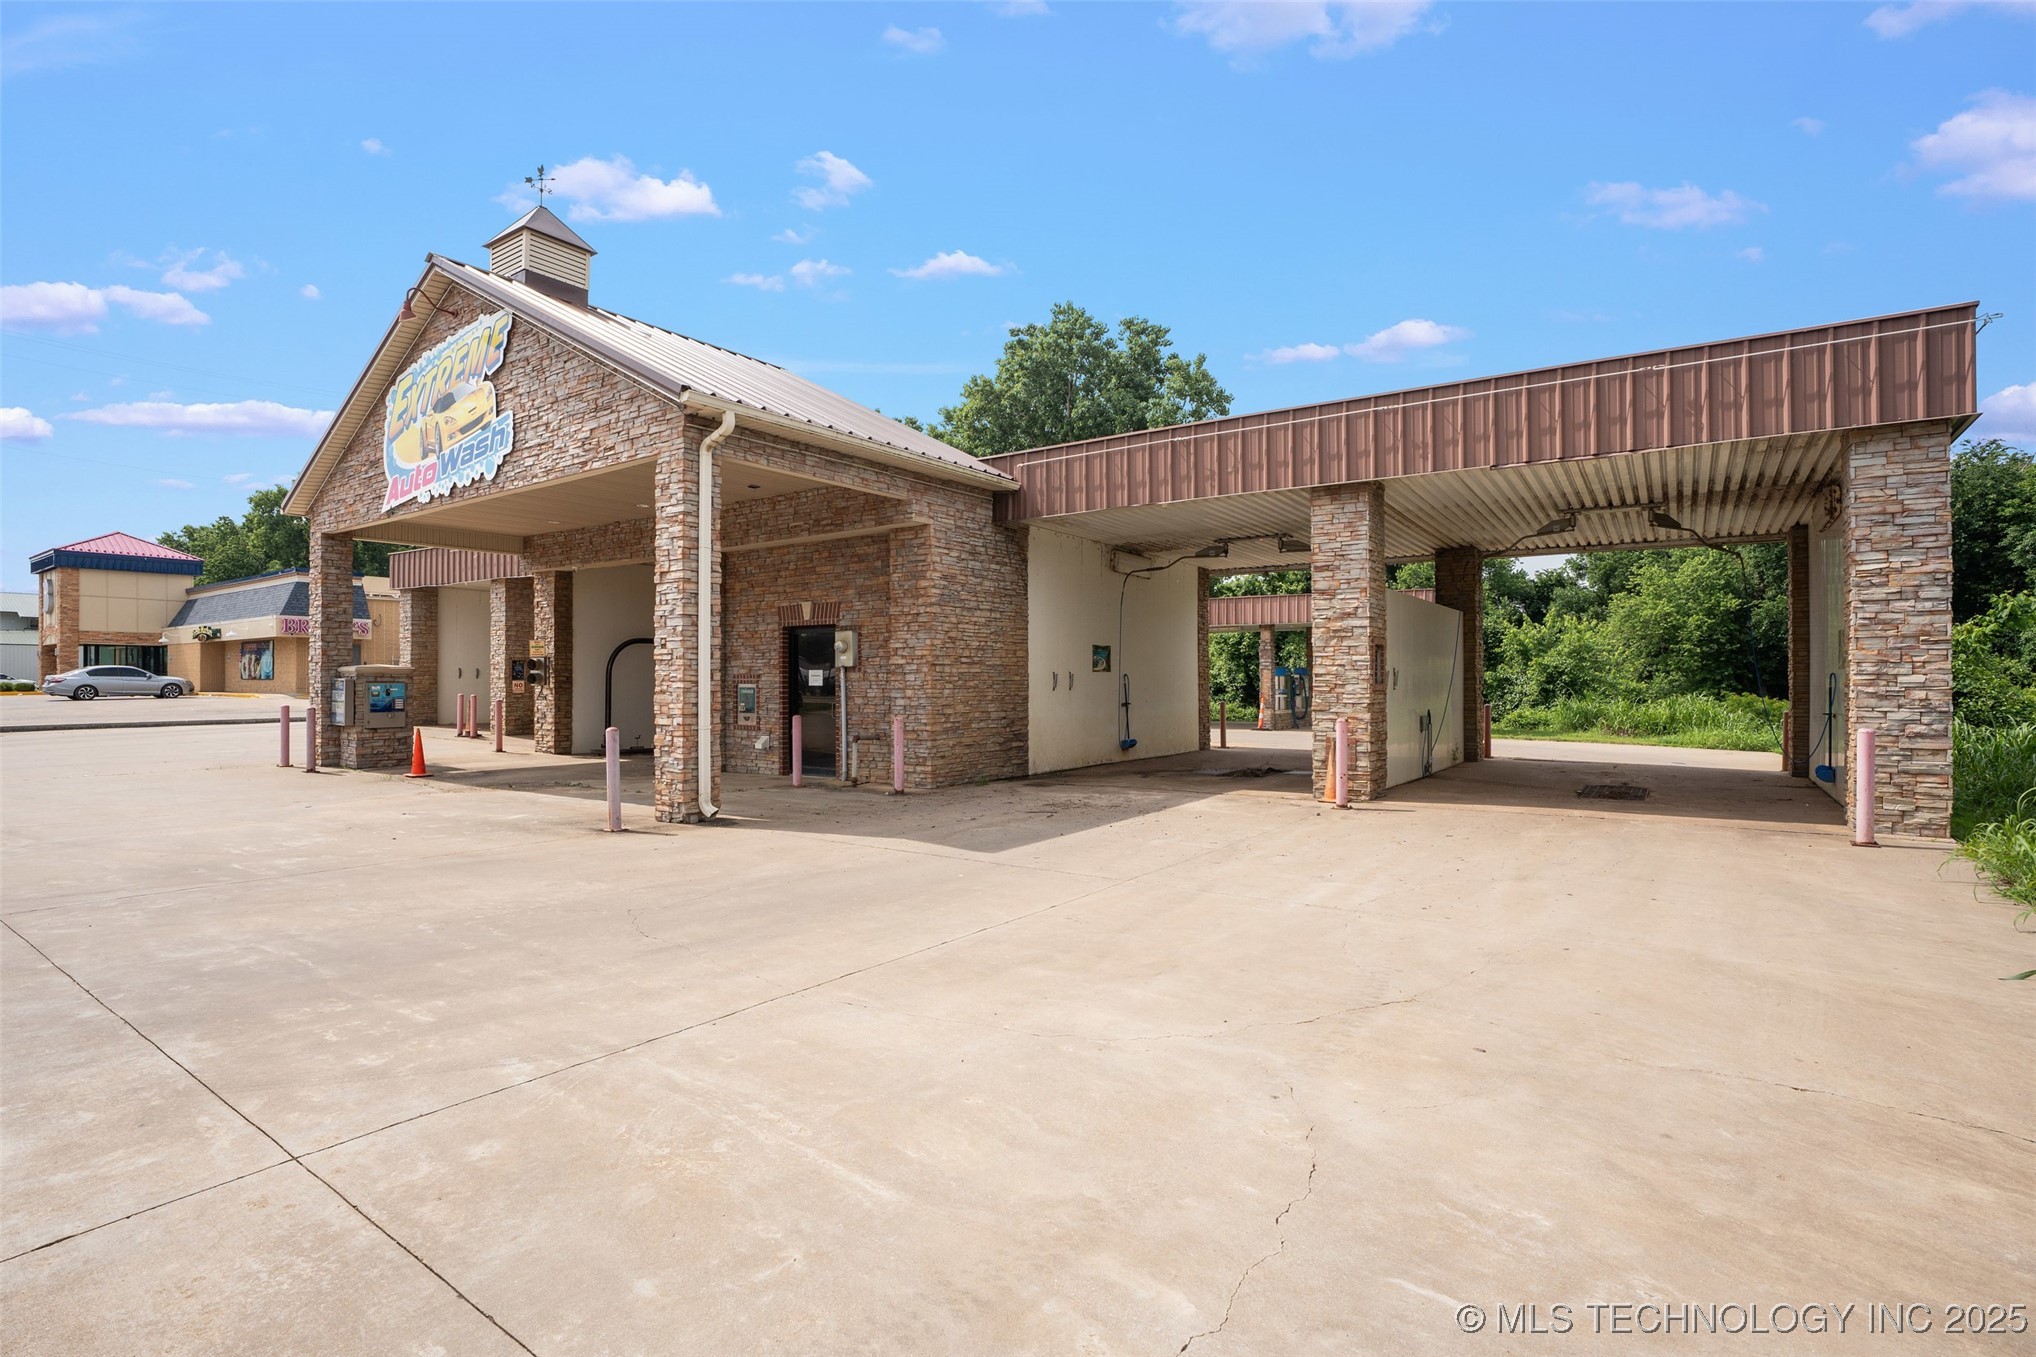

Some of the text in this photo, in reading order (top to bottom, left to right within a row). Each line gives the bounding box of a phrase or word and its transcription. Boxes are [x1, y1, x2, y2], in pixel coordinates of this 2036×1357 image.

[389, 313, 510, 442] EXTREME
[386, 424, 507, 505] Auto Wash
